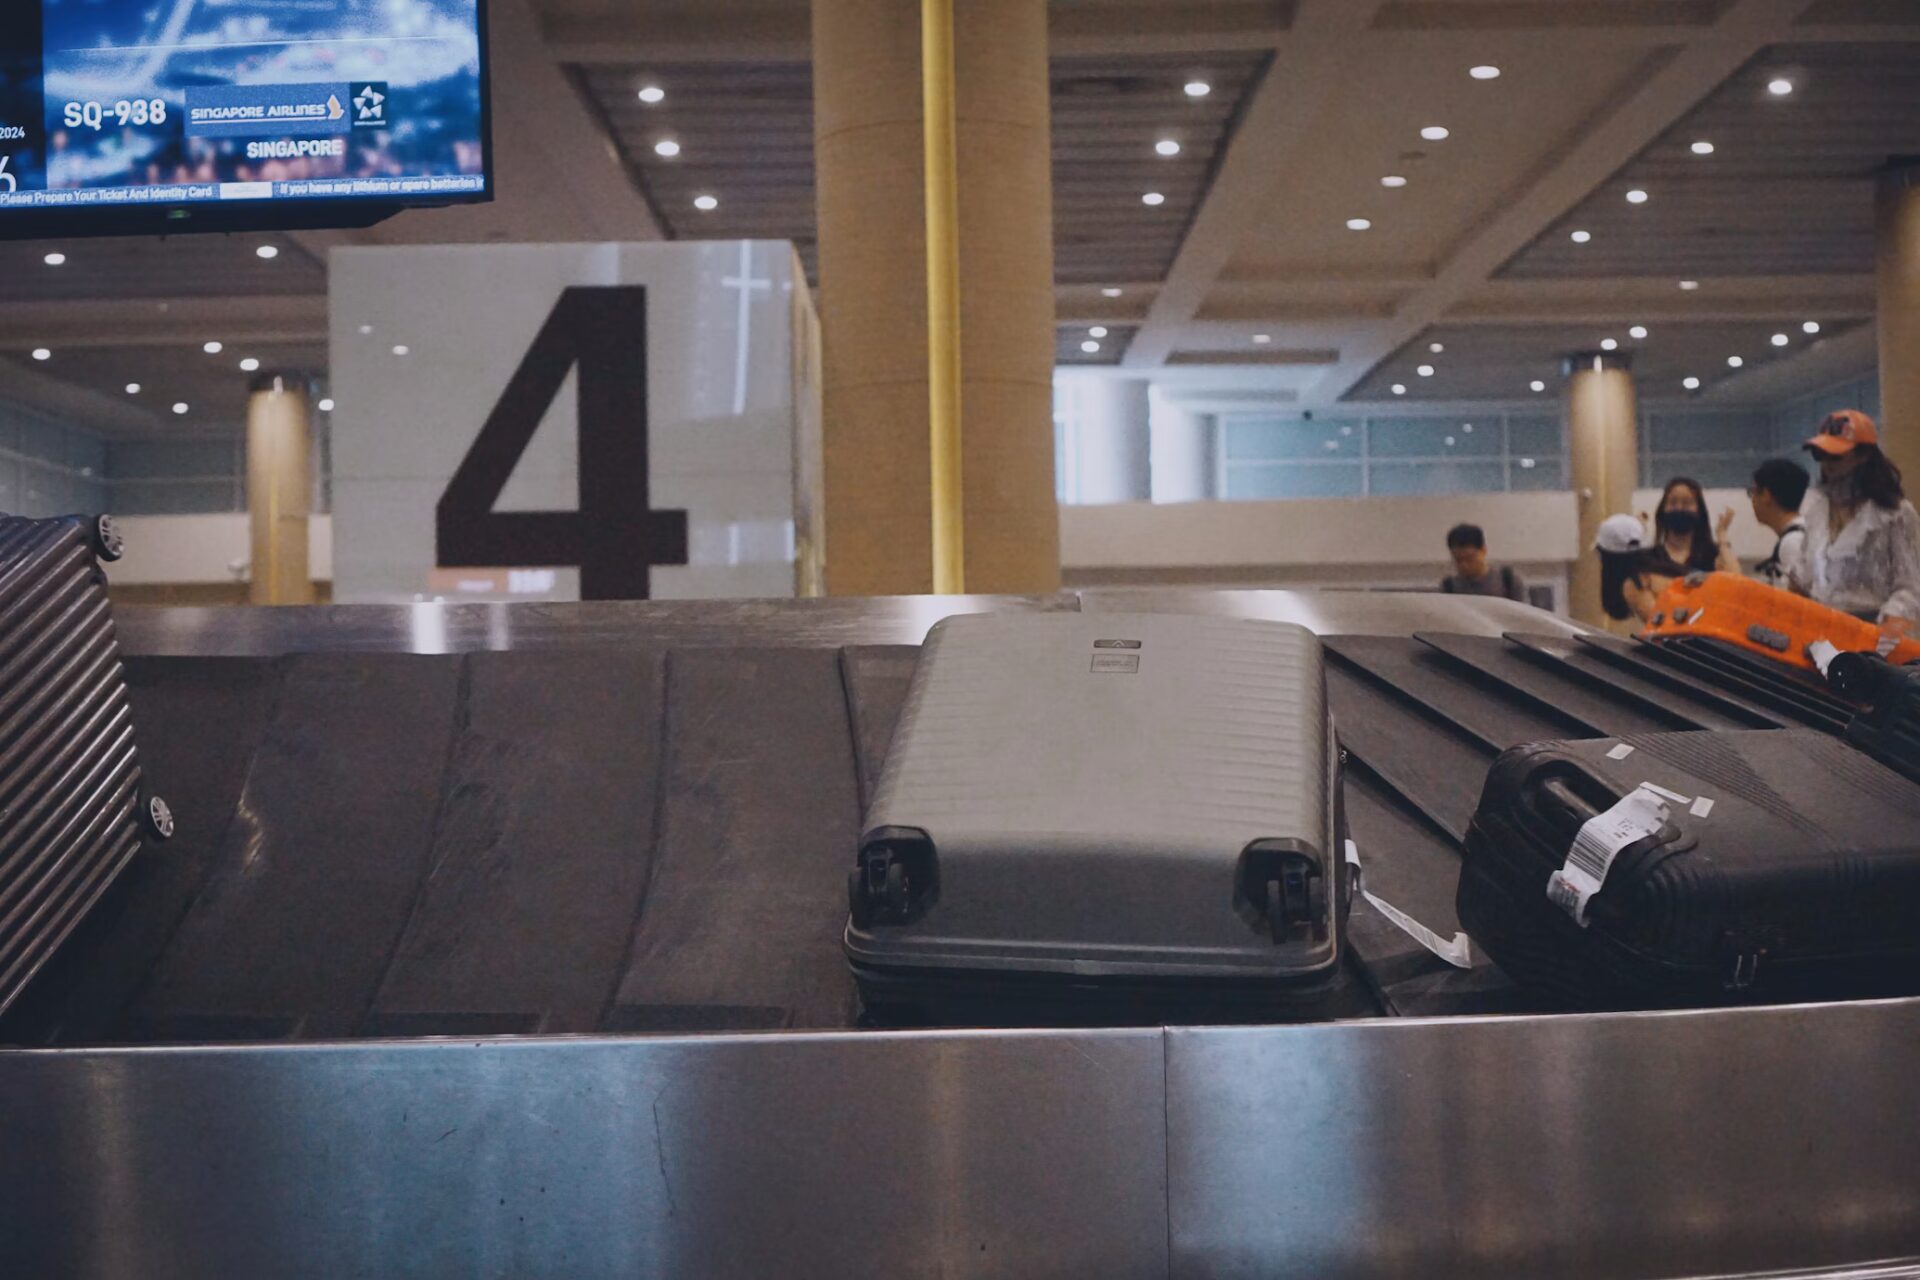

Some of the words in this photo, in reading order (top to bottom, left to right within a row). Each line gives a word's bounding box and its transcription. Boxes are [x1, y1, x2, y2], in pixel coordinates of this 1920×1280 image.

[64, 98, 167, 131] SQ-938
[191, 106, 264, 120] SINGAPORE
[267, 103, 326, 117] AIRLINES
[0, 126, 26, 139] 2024
[246, 139, 344, 159] SINGAPORE
[0, 193, 33, 204] Please
[34, 192, 73, 203] Prepare
[74, 190, 97, 201] Your
[98, 189, 127, 200] Ticket
[129, 188, 149, 199] And
[150, 187, 187, 199] Identity
[188, 186, 213, 197] Card
[280, 183, 288, 194] If
[289, 184, 308, 196] you
[308, 182, 333, 193] have
[333, 183, 353, 194] any
[353, 180, 389, 192] lithium
[389, 181, 401, 191] or
[401, 181, 430, 192] spare
[430, 177, 476, 190] batteries
[435, 284, 690, 600] 4
